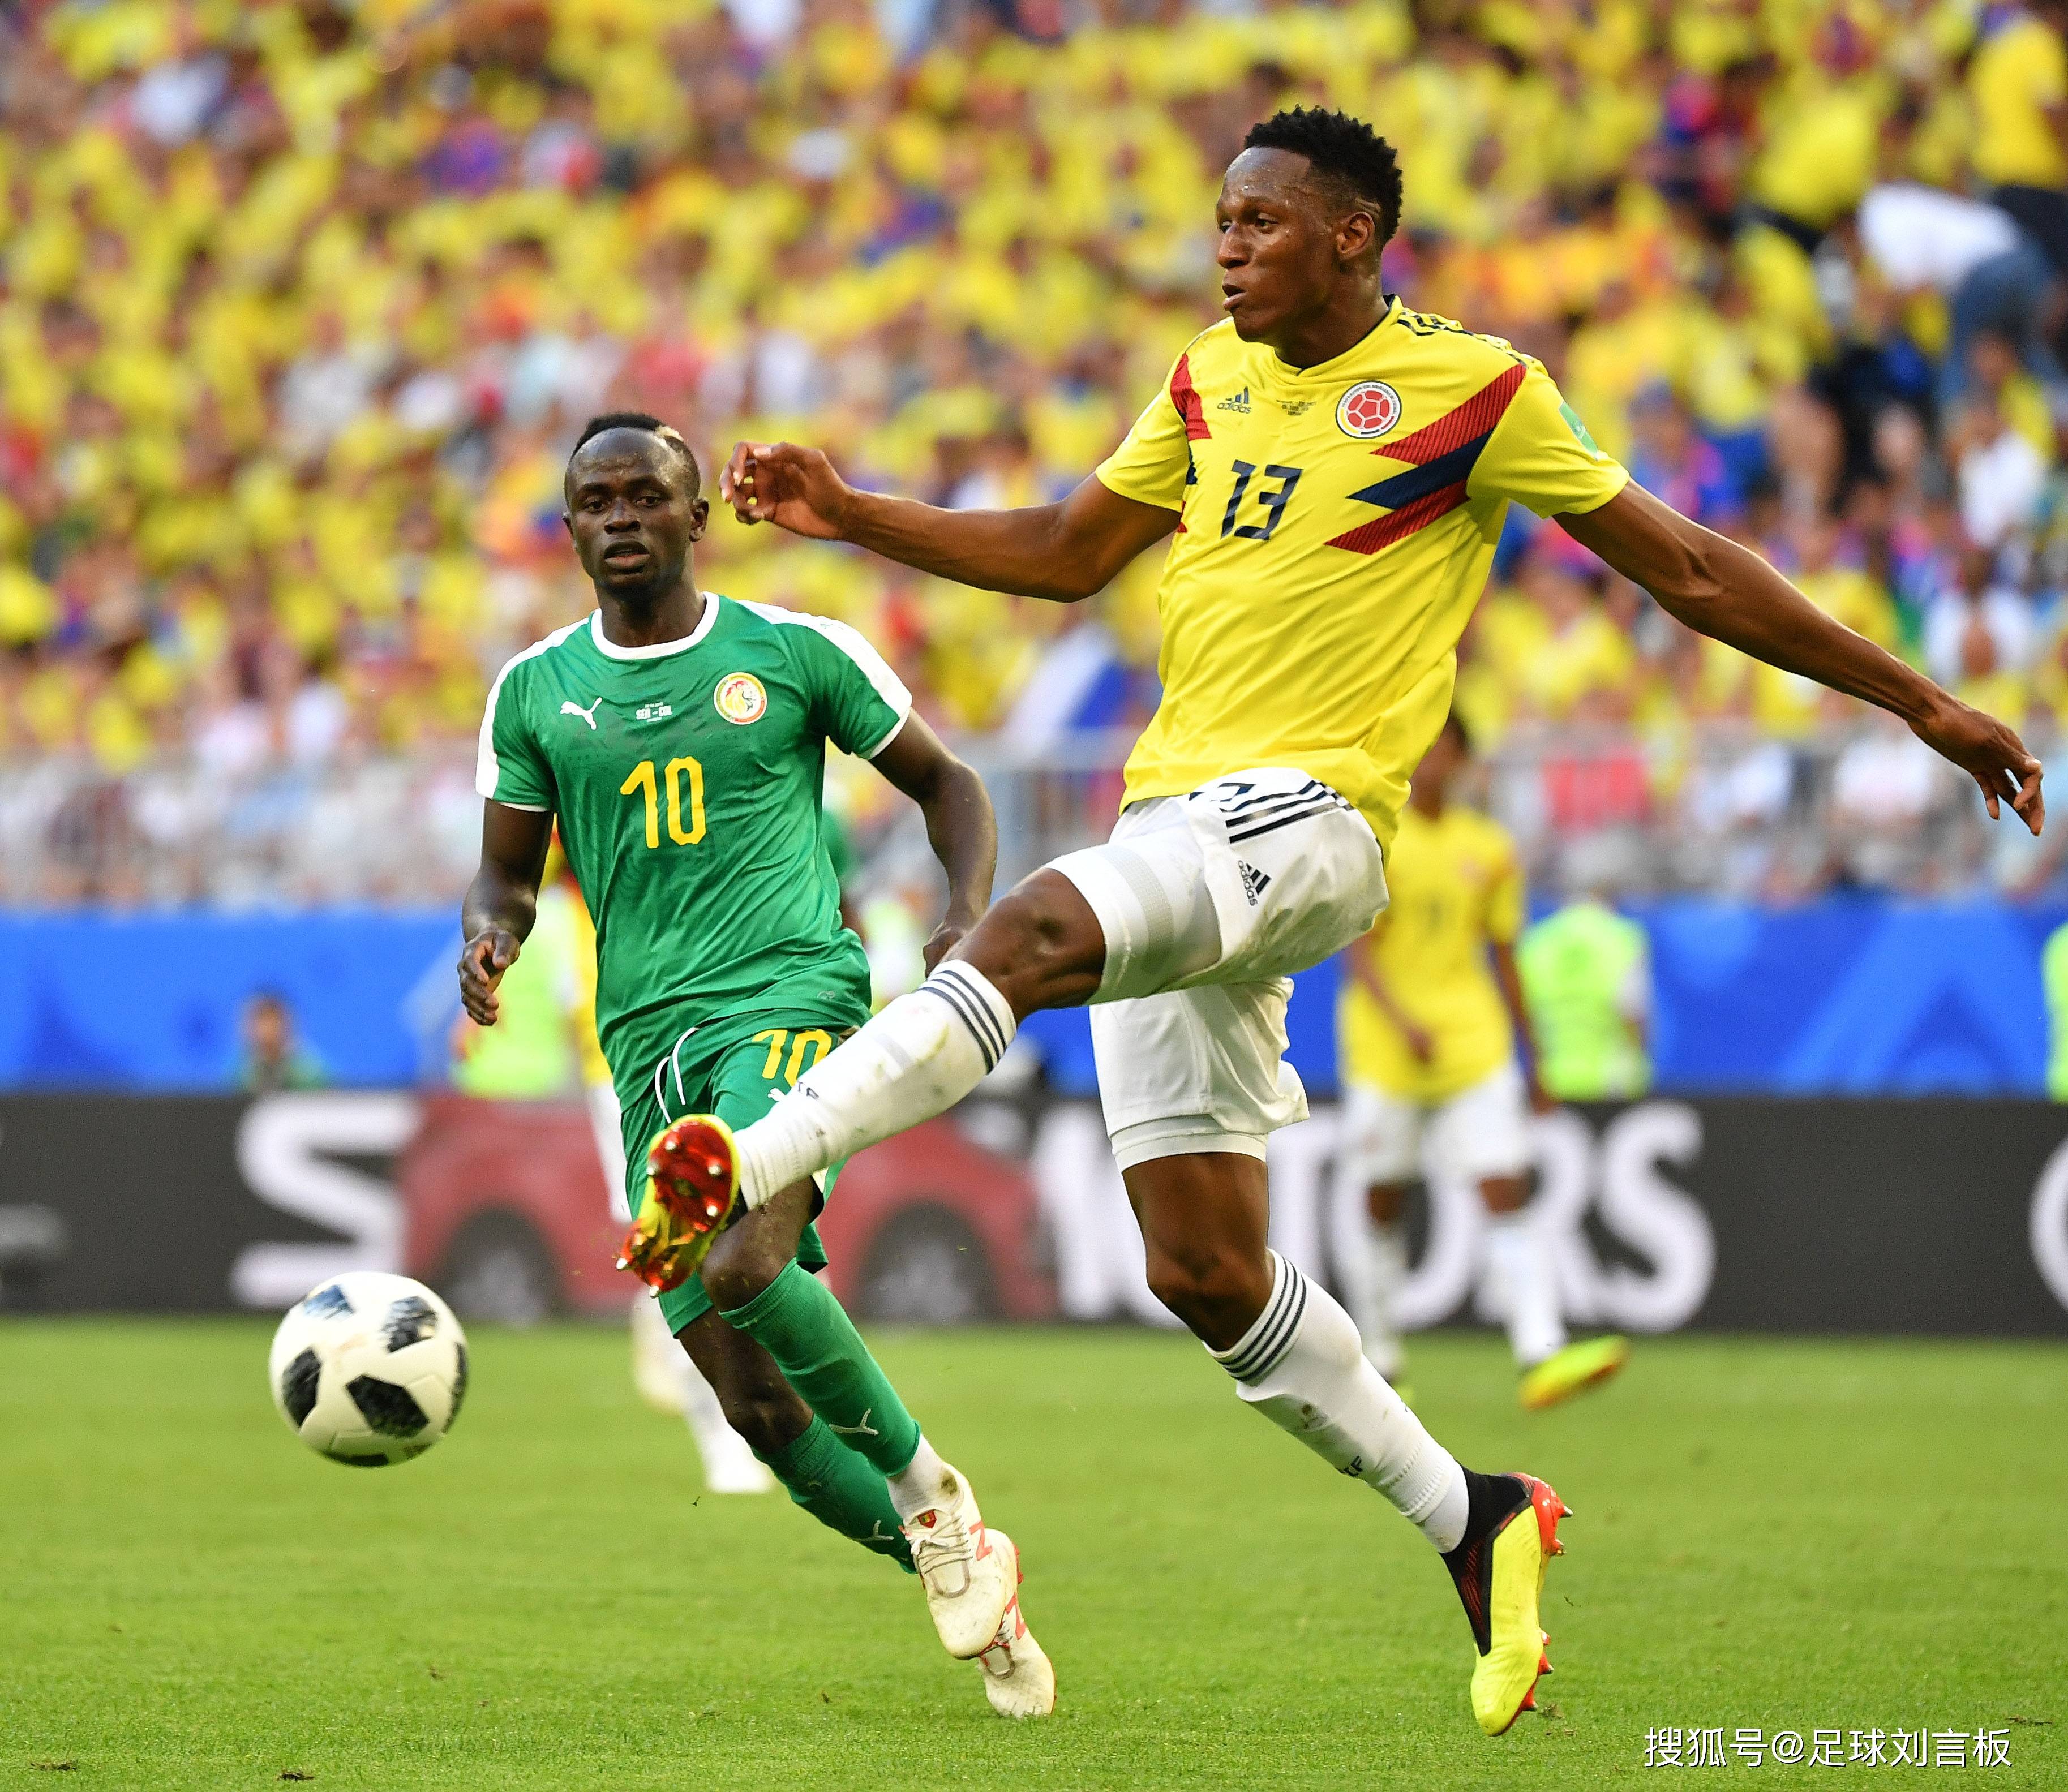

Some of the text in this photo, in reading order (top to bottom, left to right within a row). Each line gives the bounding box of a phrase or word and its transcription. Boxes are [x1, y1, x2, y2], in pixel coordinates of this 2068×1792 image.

[1217, 401, 1252, 414] adidas
[1220, 459, 1303, 540] 13
[620, 755, 706, 849] 10
[1238, 860, 1258, 906] adidas
[752, 1029, 833, 1087] 10
